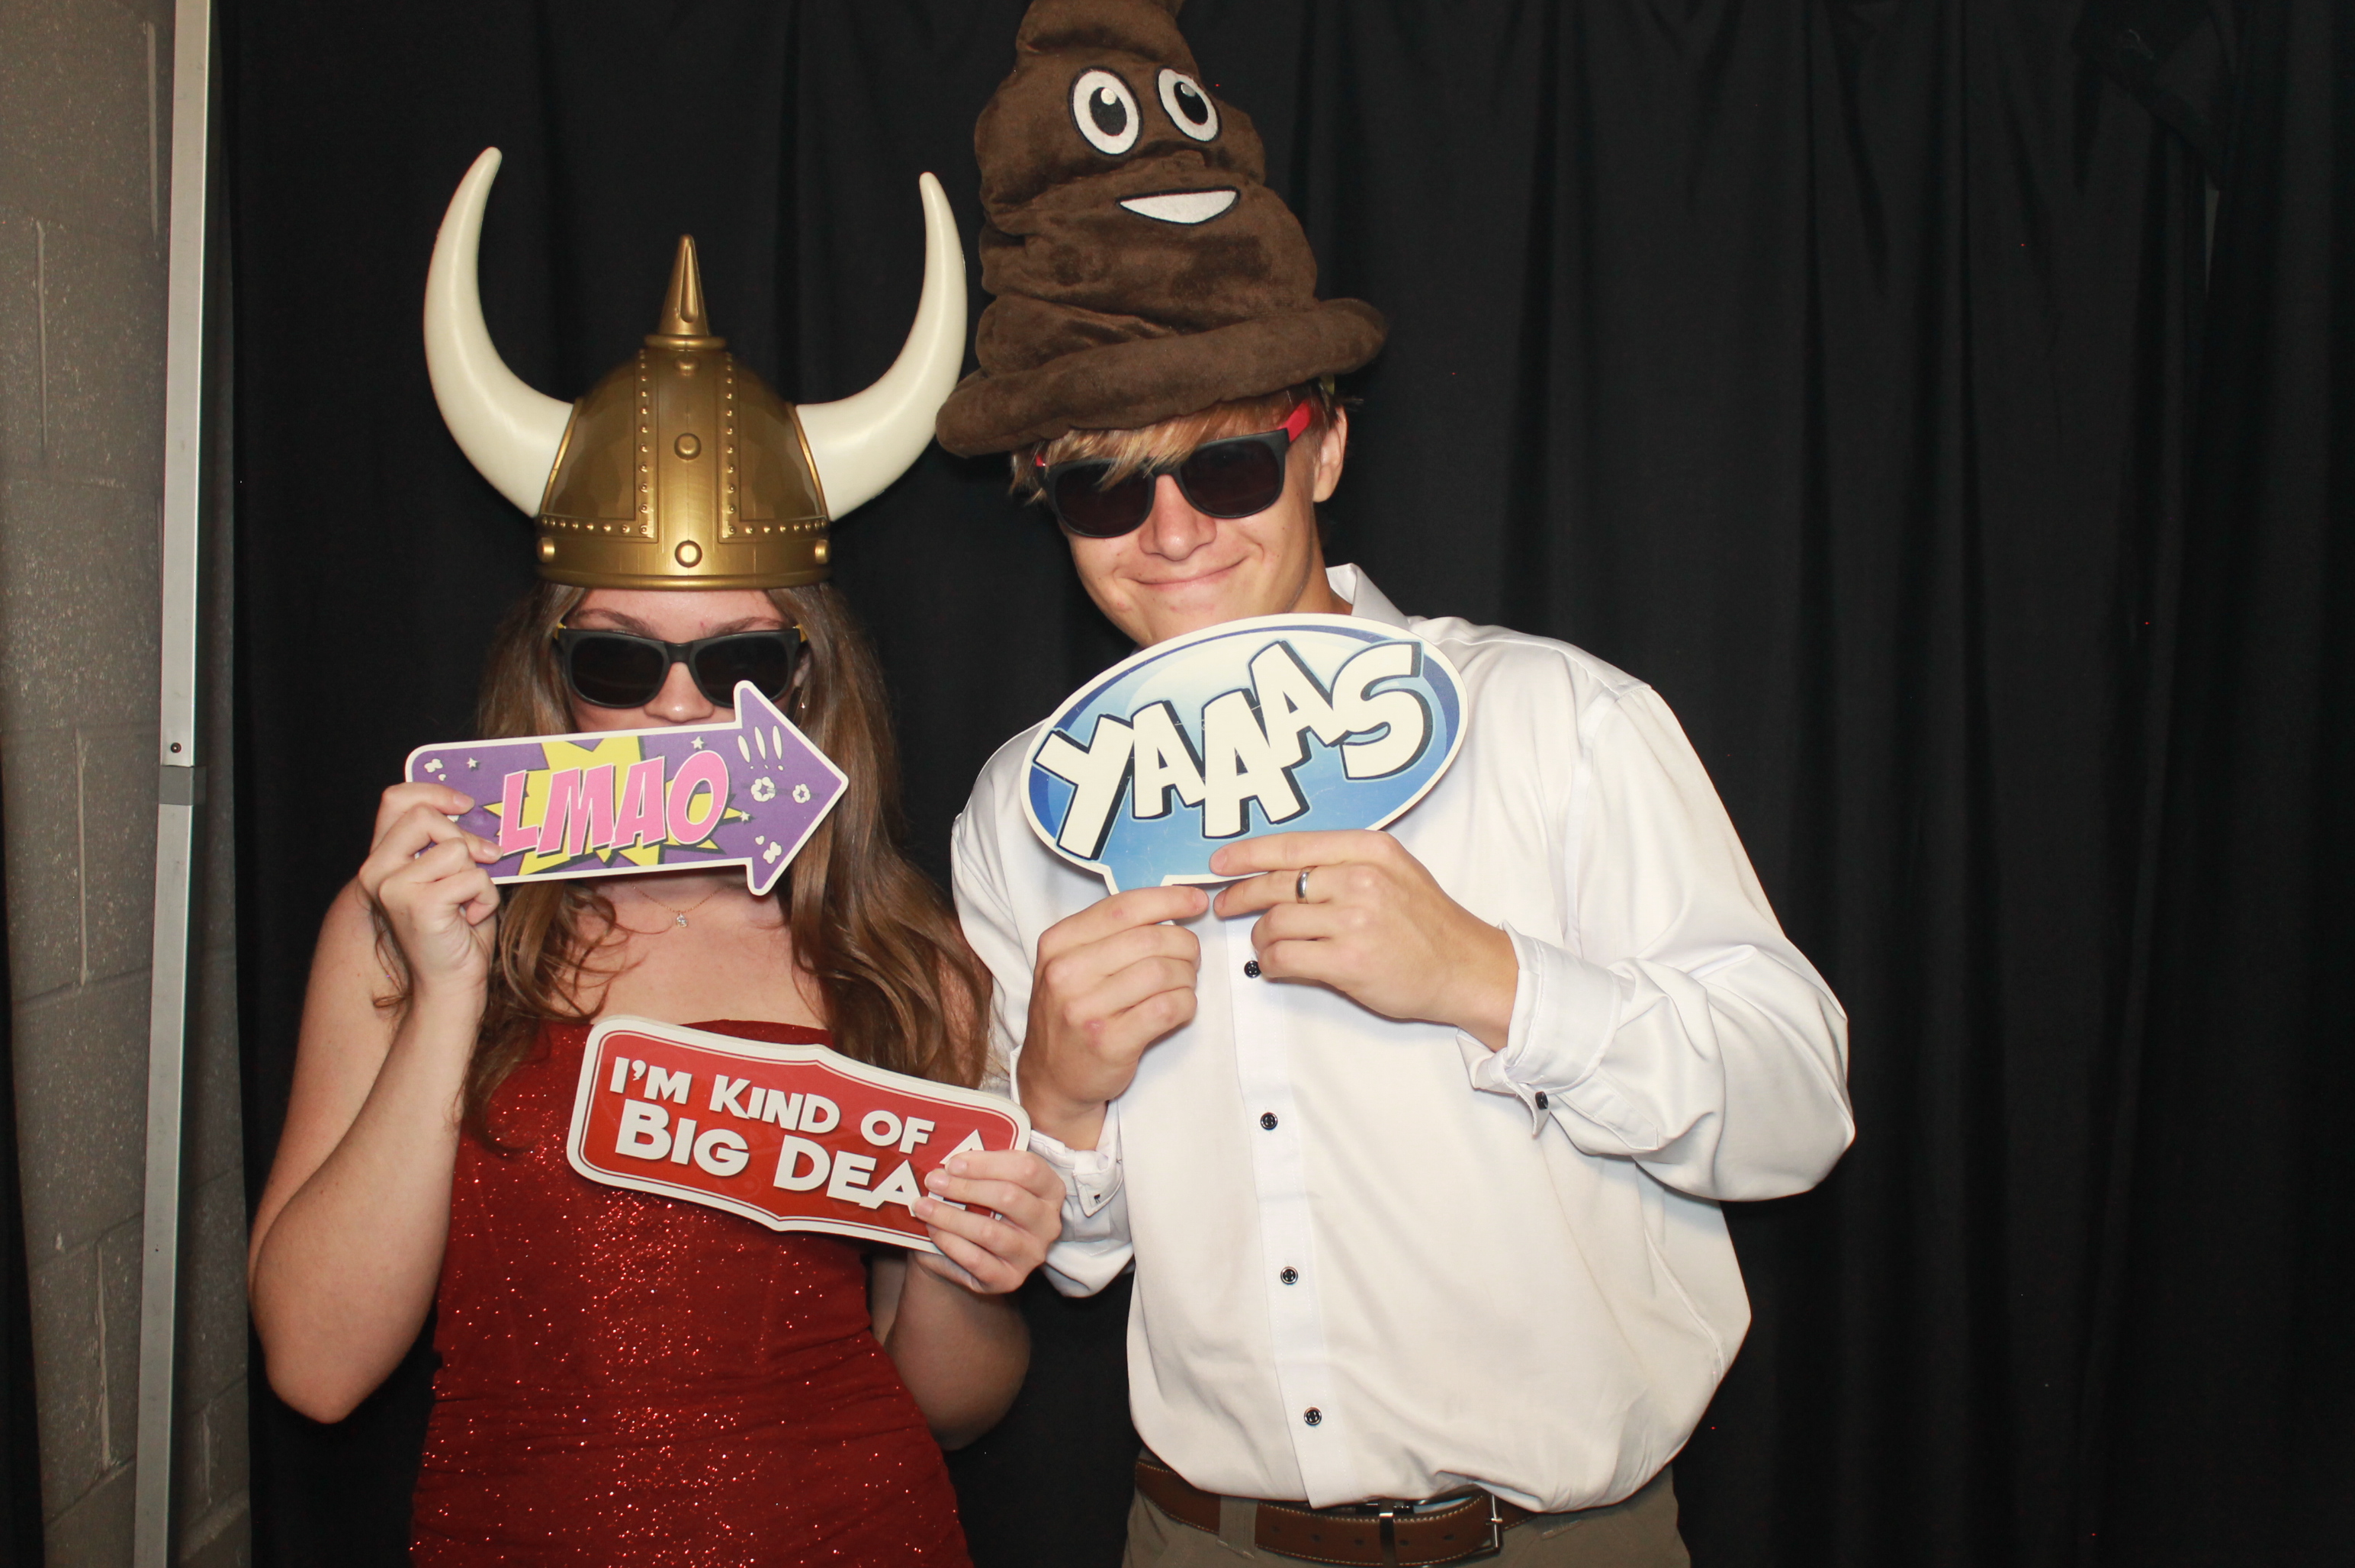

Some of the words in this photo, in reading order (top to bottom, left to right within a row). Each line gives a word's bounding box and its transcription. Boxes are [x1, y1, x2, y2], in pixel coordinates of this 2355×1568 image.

[1033, 640, 1434, 860] YAAAS
[499, 749, 729, 857] LMAO
[609, 1056, 692, 1105] I'M
[709, 1075, 840, 1134] KIND
[860, 1110, 936, 1155] OF
[615, 1098, 750, 1177] BIG
